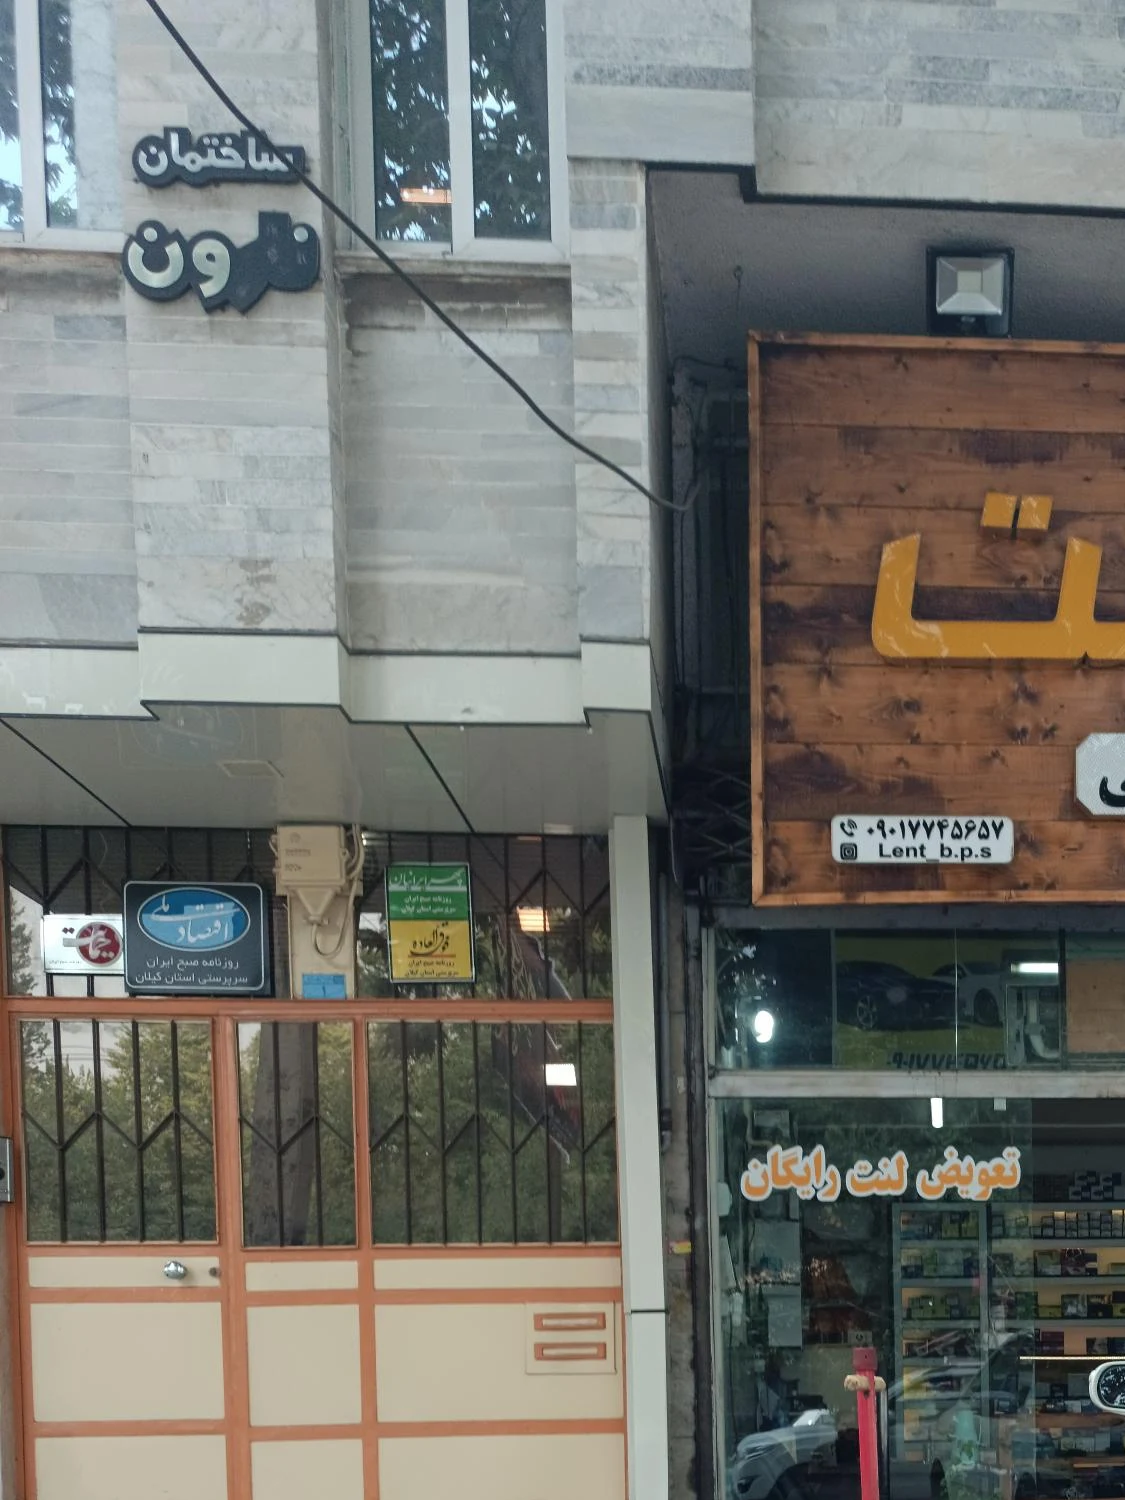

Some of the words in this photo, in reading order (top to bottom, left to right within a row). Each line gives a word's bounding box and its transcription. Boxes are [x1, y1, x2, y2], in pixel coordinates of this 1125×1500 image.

[138, 131, 294, 176] ساختمان
[866, 818, 1005, 840] ۰۹۰۱۷۷۴۵۶۵۷
[146, 956, 174, 968] ایران
[177, 959, 199, 971] صبح
[202, 957, 239, 969] روزنامه
[165, 972, 195, 984] استان
[198, 974, 248, 987] سرپرستی
[741, 1144, 841, 1201] رایگان
[846, 1150, 909, 1197] لنت
[917, 1146, 1021, 1200] تعویض
